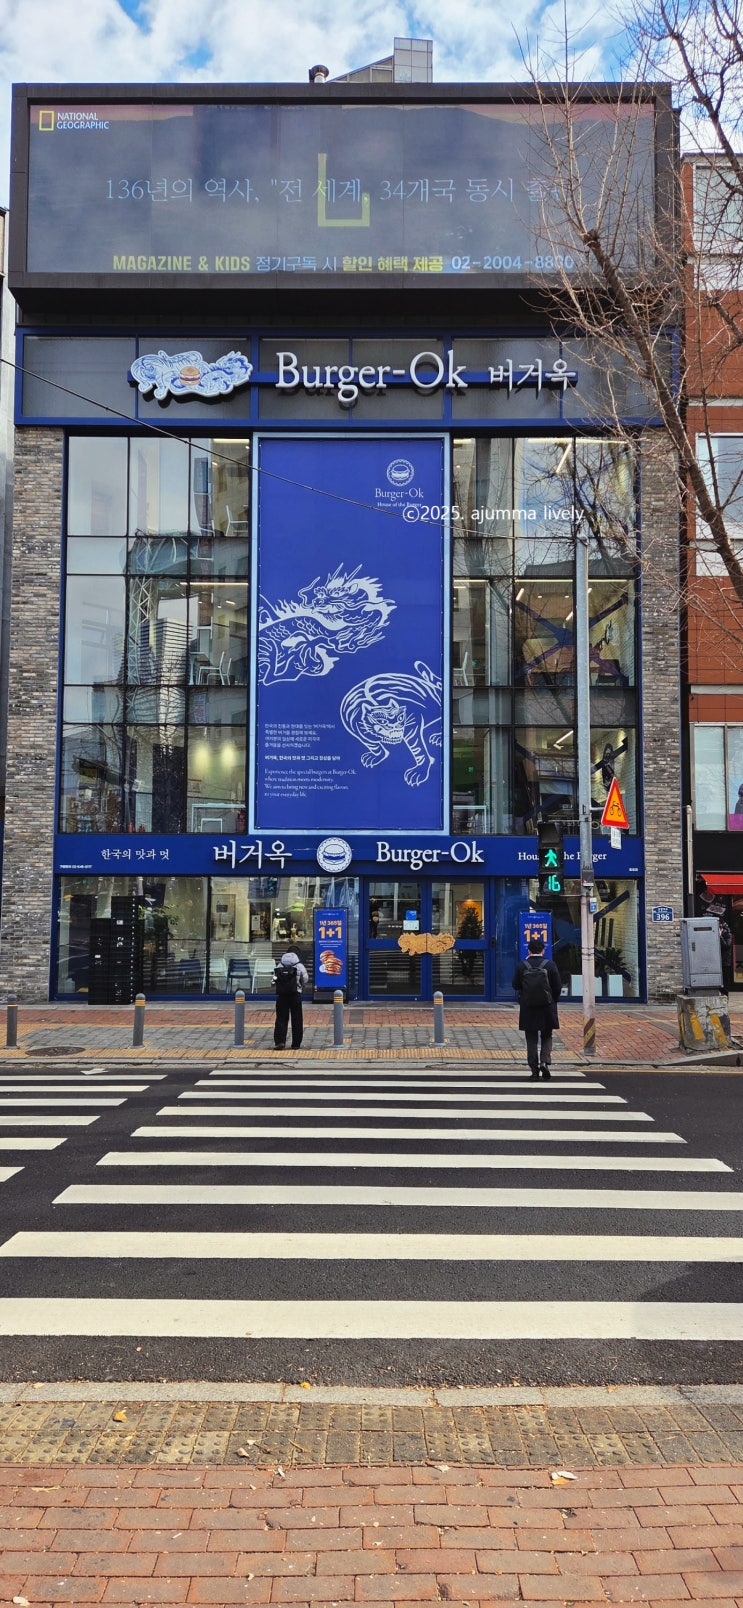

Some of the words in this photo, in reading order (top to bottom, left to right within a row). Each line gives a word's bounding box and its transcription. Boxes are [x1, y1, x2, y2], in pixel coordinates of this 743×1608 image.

[57, 112, 98, 121] NATIONAL
[56, 121, 110, 130] GEOGRAPHIC
[106, 178, 194, 203] 136년의
[204, 178, 260, 203] 역사,
[270, 178, 302, 203] "전
[312, 178, 370, 204] 세계,
[380, 178, 456, 203] 34개국
[466, 178, 514, 203] 동시
[112, 255, 192, 272] MAGAZINE
[198, 255, 209, 272] &
[215, 255, 250, 272] KIDS
[256, 256, 318, 272] 정기구독
[322, 256, 338, 272] 시
[342, 256, 373, 272] 할인
[377, 256, 409, 272] 혜택
[413, 256, 444, 272] 제공
[276, 350, 468, 402] Burger-Ok
[488, 358, 577, 394] 버거옥
[375, 487, 424, 502] Burger-Ok
[101, 848, 132, 860] 한국의
[135, 848, 156, 860] 맛과
[160, 848, 170, 860] 멋
[212, 840, 292, 870] 버거옥
[376, 841, 484, 870] Burger-Ok
[548, 874, 561, 892] 16
[318, 926, 342, 939] 1+1
[524, 930, 548, 942] 1+1
